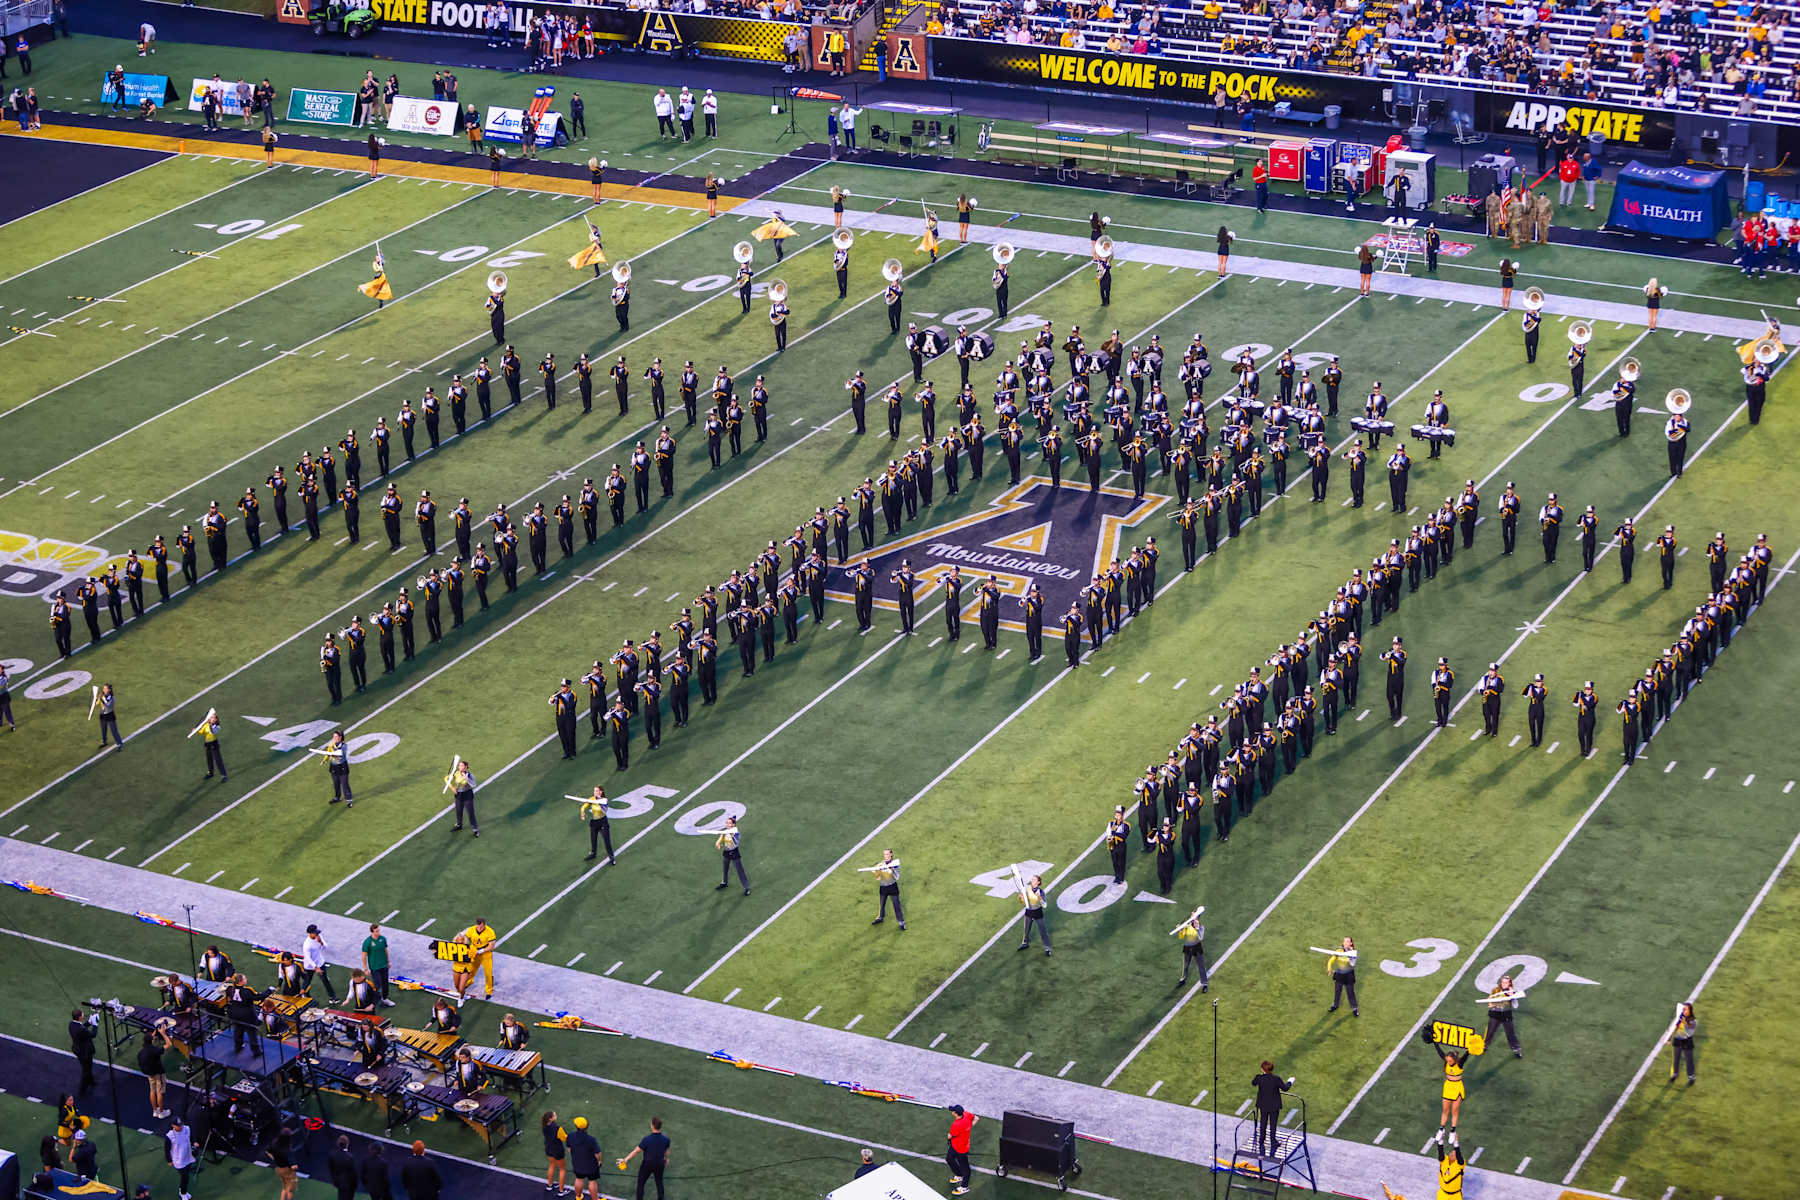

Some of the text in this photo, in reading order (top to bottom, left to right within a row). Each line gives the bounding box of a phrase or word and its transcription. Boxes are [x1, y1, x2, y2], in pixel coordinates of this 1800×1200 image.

[430, 0, 534, 33] FOOTLL
[892, 37, 920, 73] A
[1039, 53, 1158, 90] WELCOME
[1159, 70, 1178, 87] TO
[1180, 72, 1207, 90] THE
[304, 101, 339, 113] GENERAL
[305, 93, 327, 103] MAST
[308, 110, 332, 120] STORE
[1642, 204, 1703, 223] HEALTH
[921, 334, 938, 355] A
[969, 338, 985, 358] A
[1032, 353, 1045, 370] A
[925, 541, 1082, 580] Mountaineers
[437, 941, 468, 962] APP
